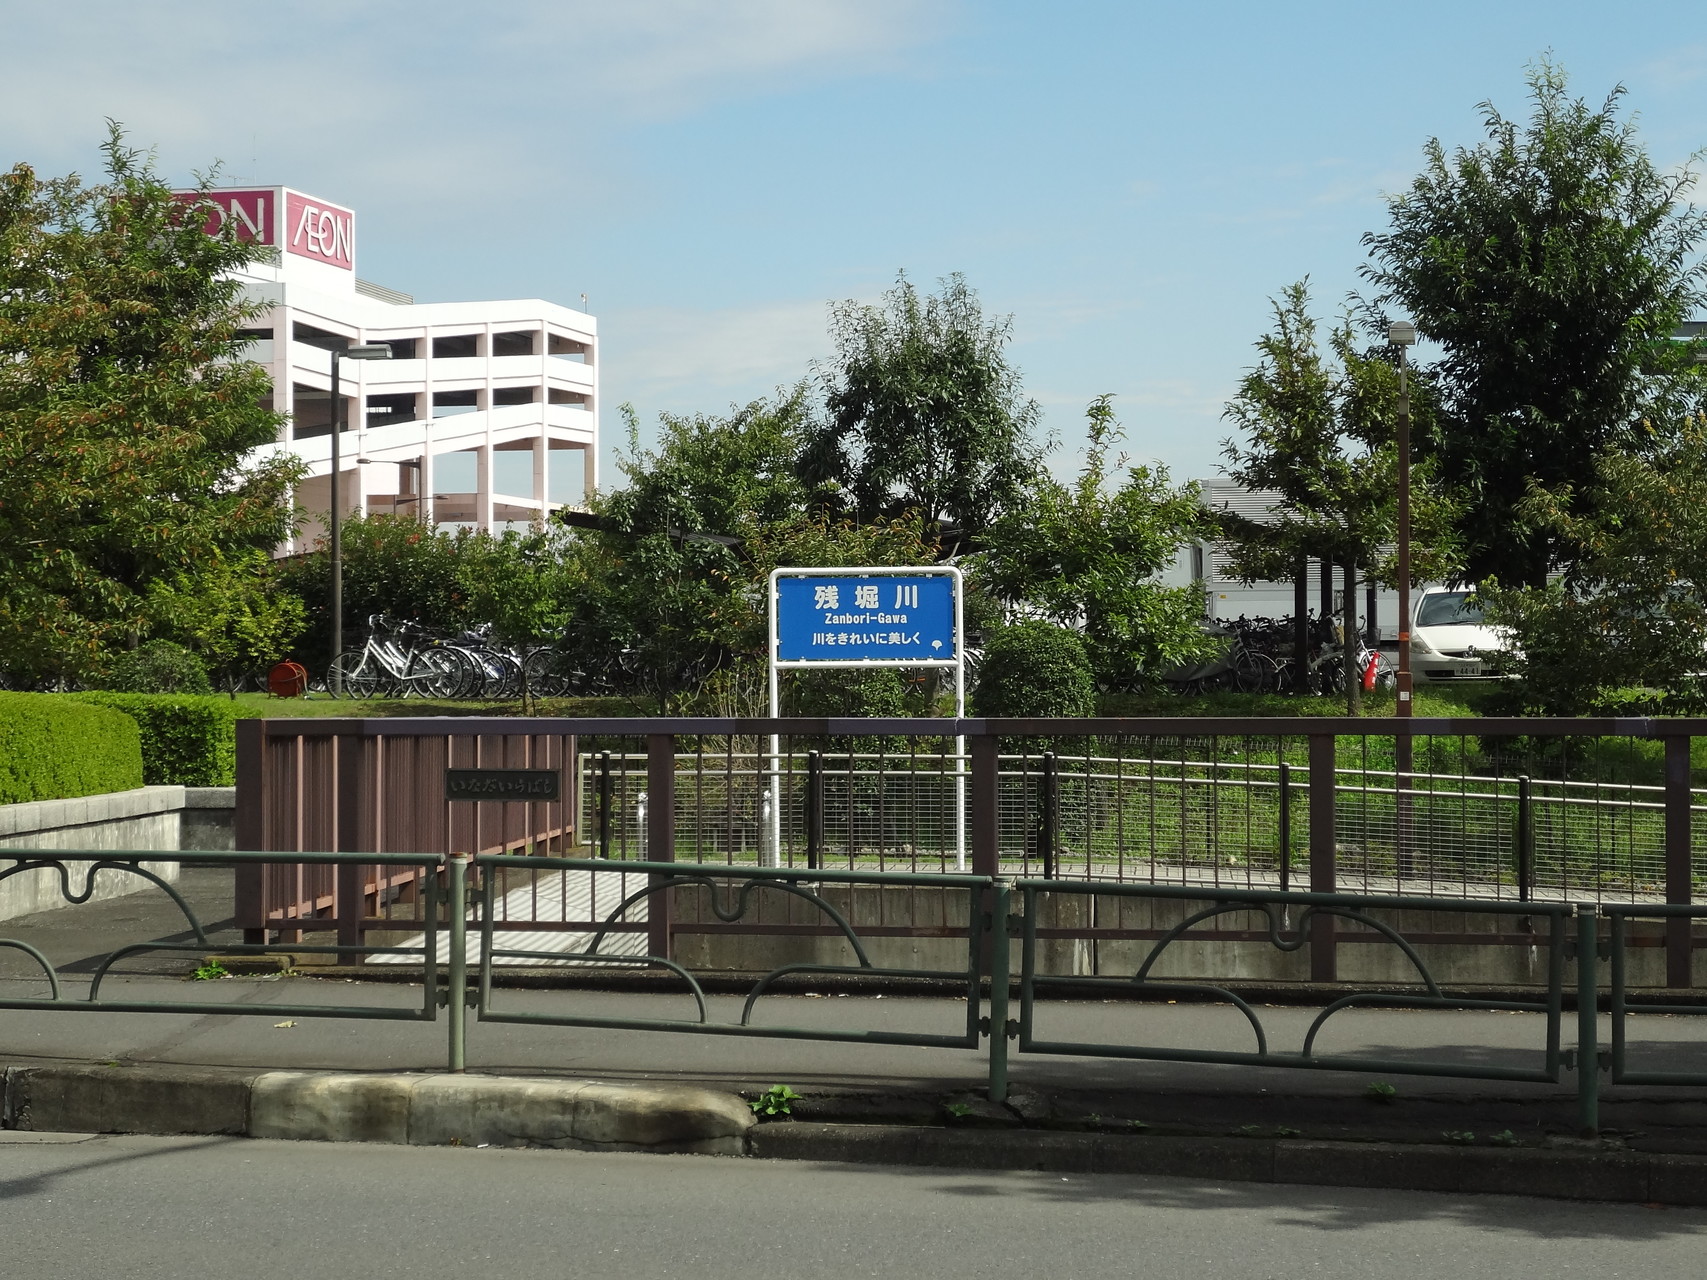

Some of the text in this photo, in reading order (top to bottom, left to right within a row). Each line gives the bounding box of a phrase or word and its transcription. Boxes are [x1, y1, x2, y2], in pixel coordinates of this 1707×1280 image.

[814, 584, 919, 610] 残堀川
[824, 612, 908, 625] Zanbori-Gawa
[812, 631, 921, 646] 川をきれいに美しく
